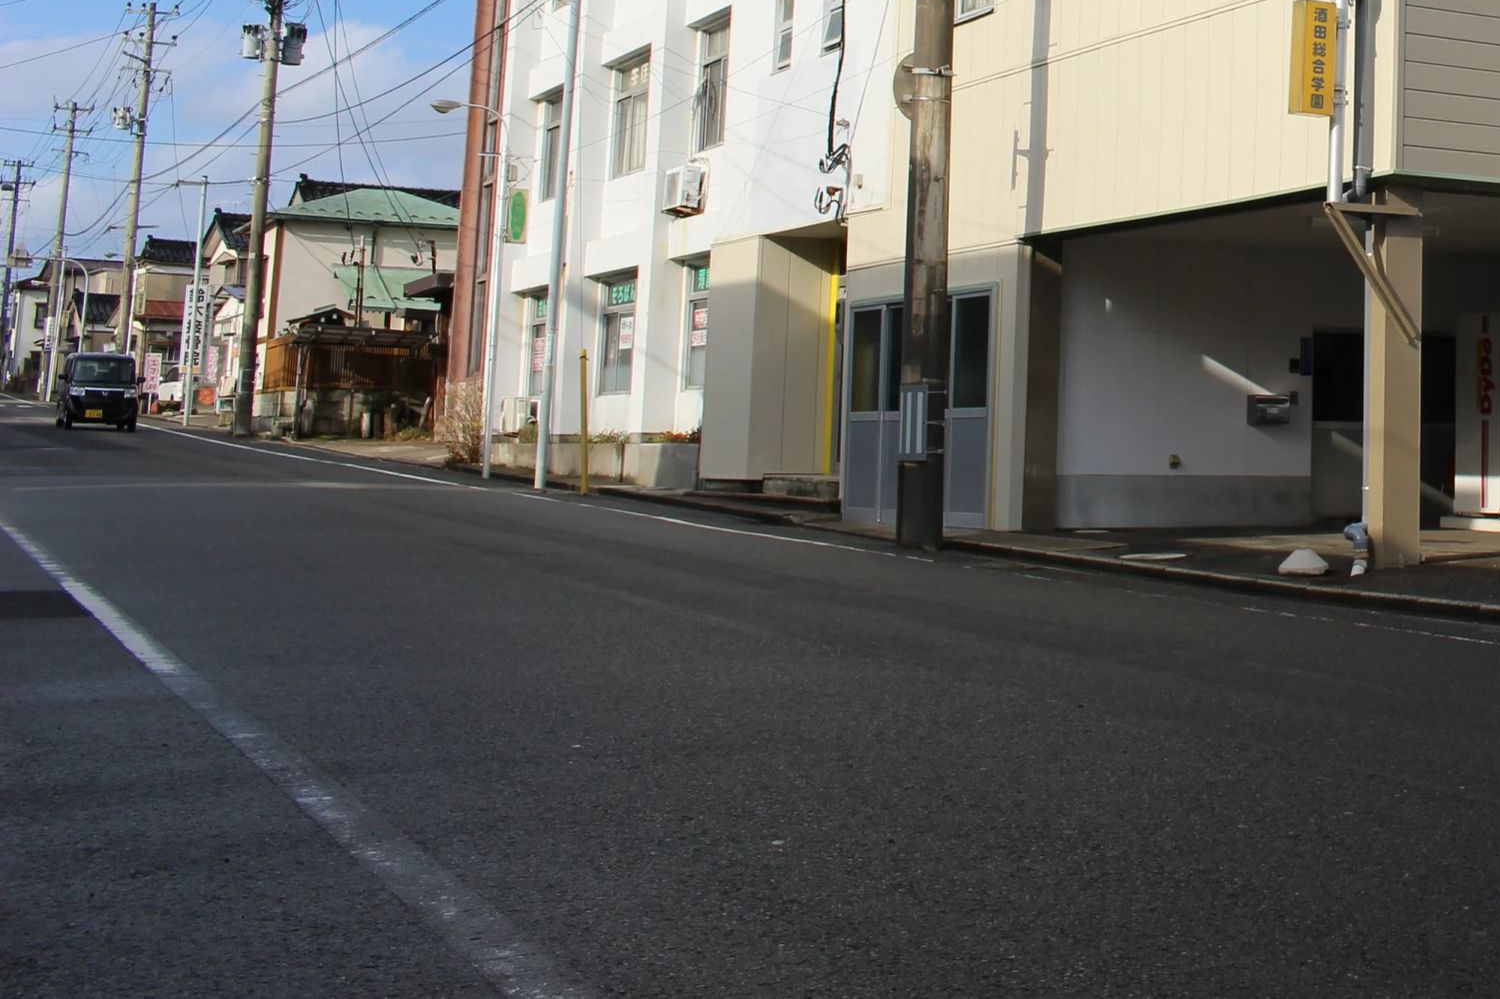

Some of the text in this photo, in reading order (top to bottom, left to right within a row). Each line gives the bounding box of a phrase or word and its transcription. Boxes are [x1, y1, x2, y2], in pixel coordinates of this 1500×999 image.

[1311, 7, 1328, 109] 酒田総合学園
